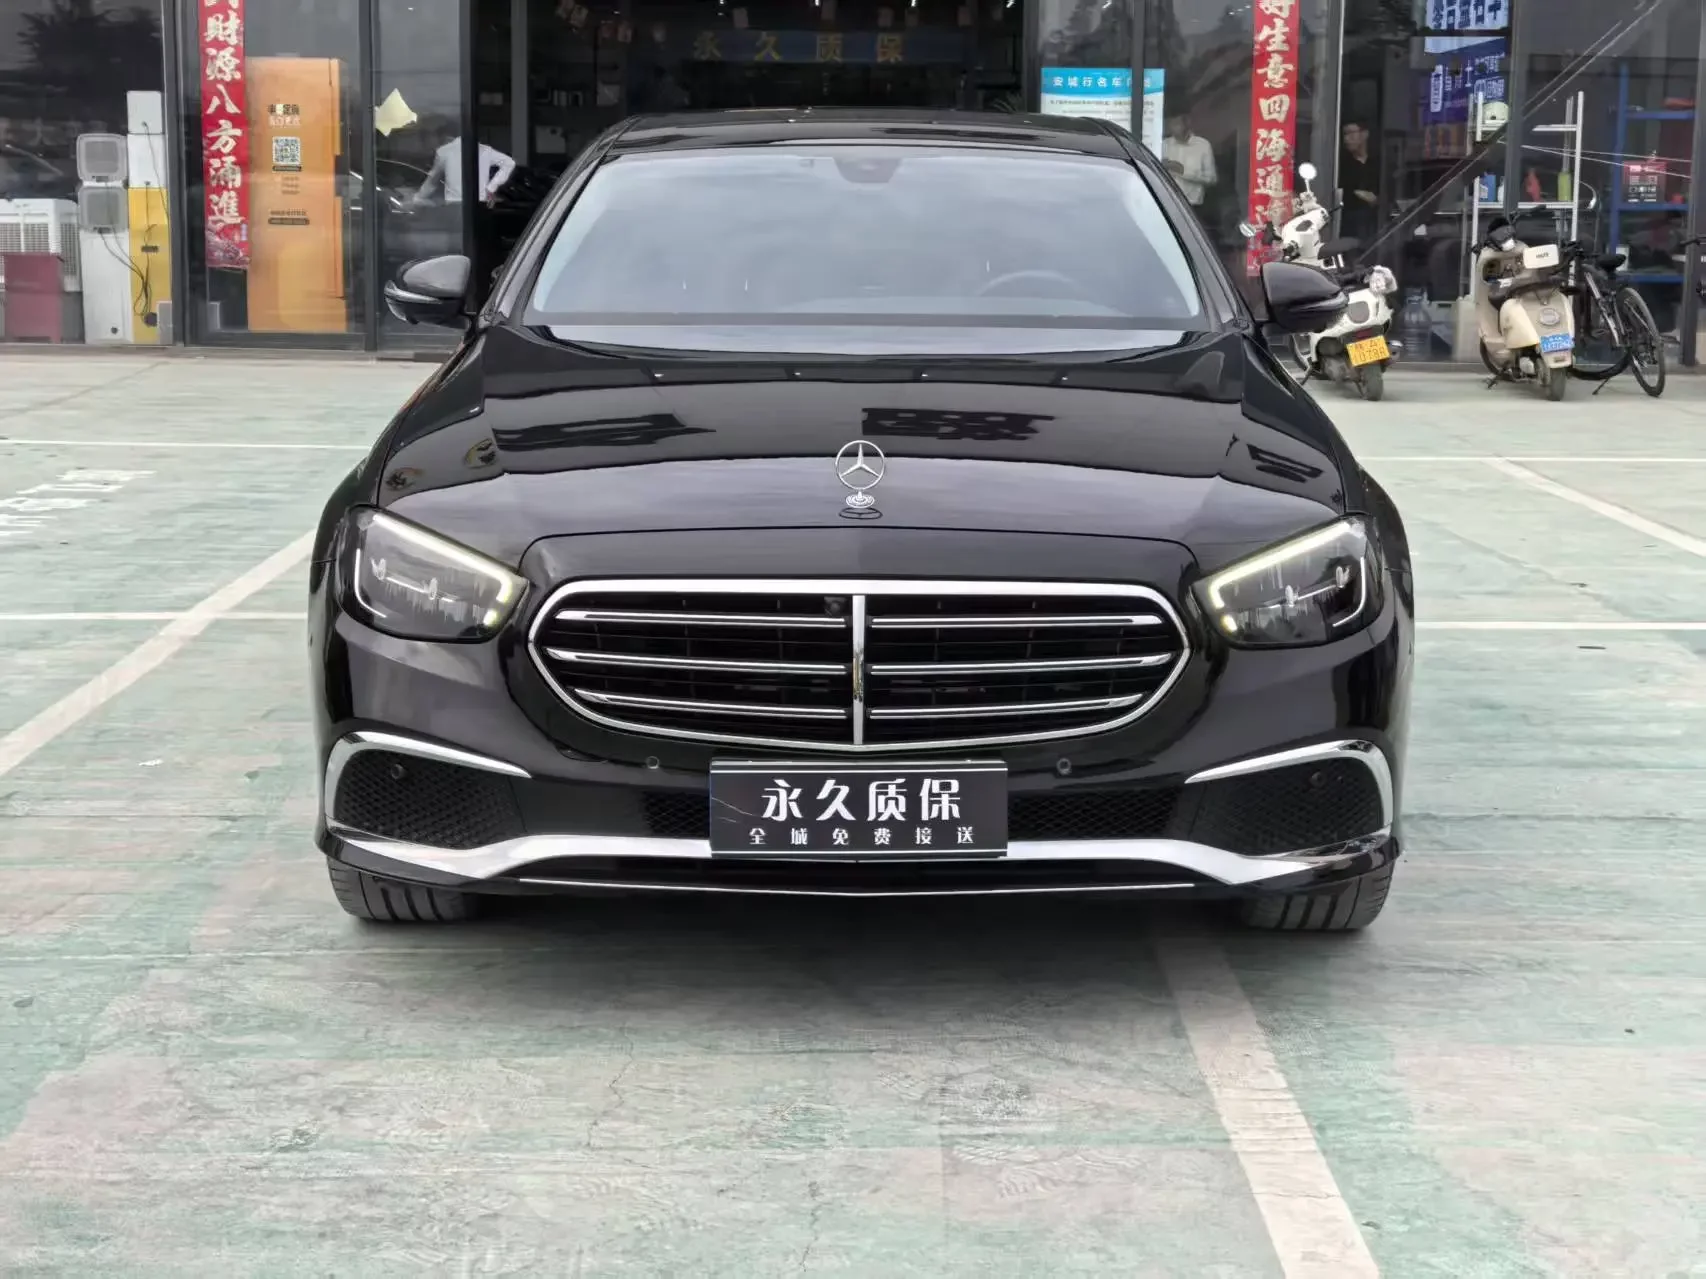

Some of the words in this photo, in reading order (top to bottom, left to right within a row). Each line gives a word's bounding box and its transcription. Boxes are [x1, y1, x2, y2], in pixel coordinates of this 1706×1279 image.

[693, 30, 903, 63] 永久质保
[204, 0, 245, 224] 財源八方涌進
[761, 778, 961, 822] 永久质保
[749, 826, 974, 845] 全城免费接送
